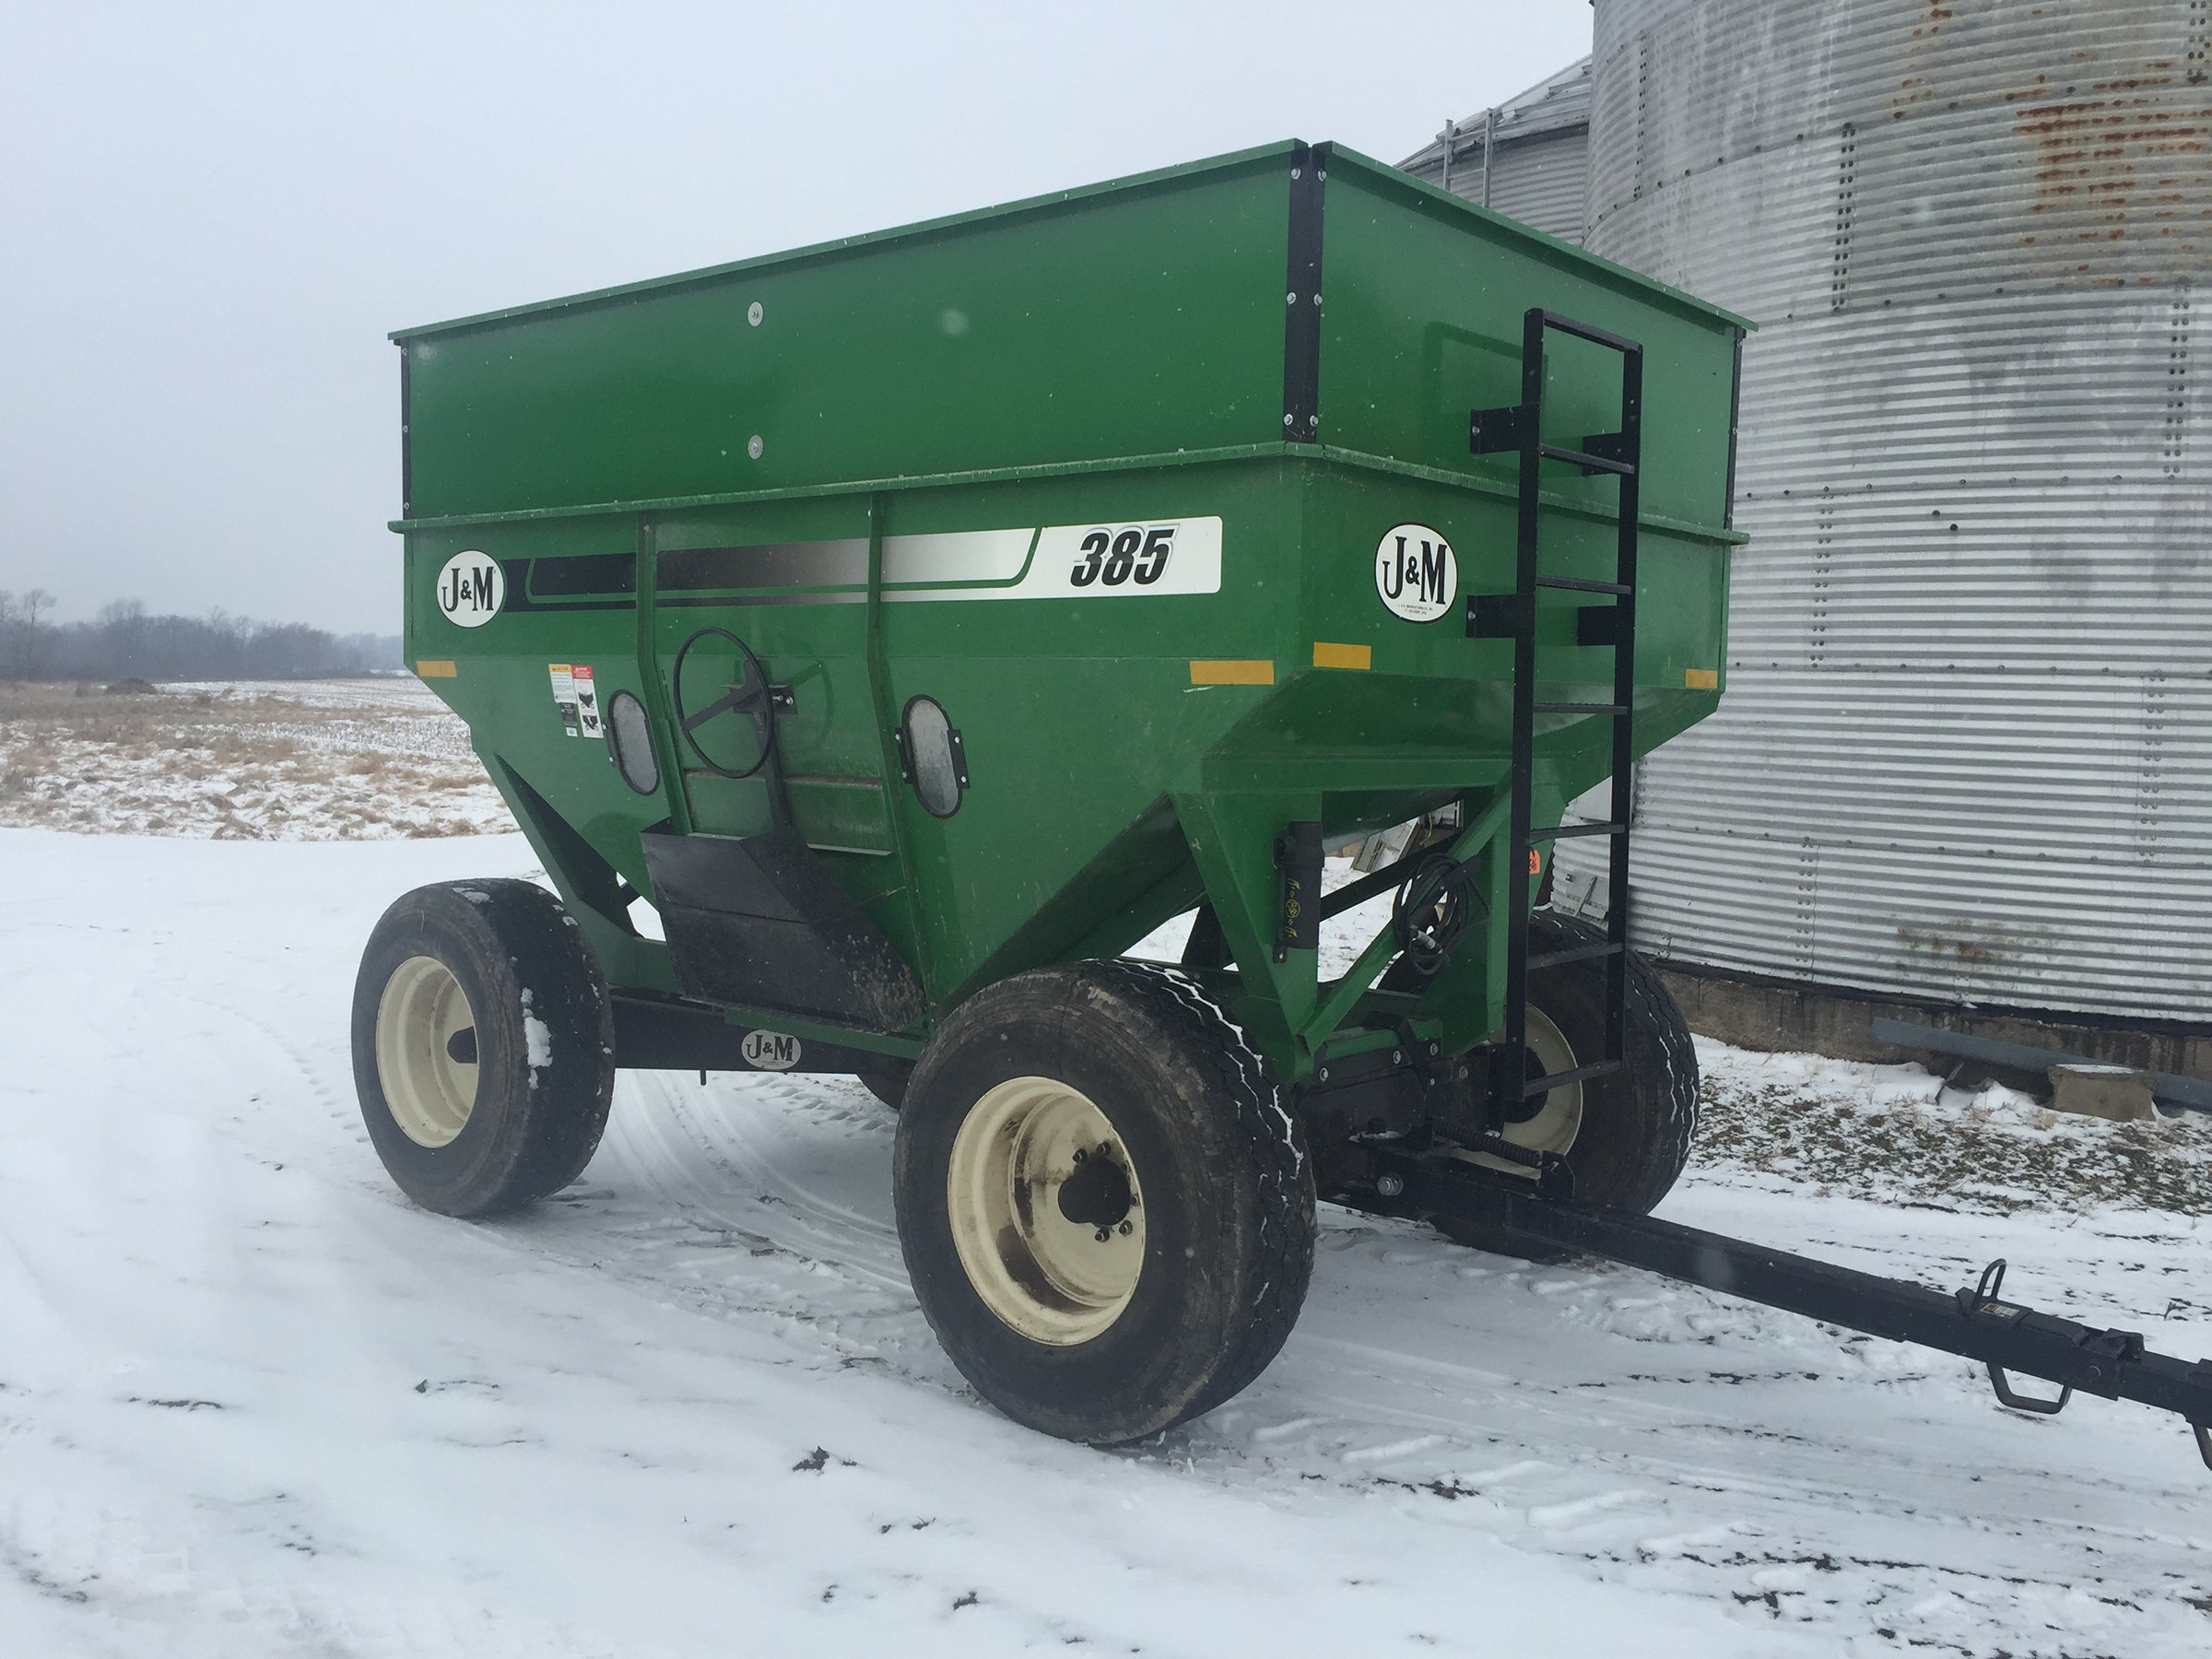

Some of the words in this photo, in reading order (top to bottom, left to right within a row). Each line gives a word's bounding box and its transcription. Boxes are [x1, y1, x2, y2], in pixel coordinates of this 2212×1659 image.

[1070, 525, 1179, 587] 385
[1382, 535, 1448, 605] J&M
[441, 566, 495, 612] J&M
[746, 1034, 794, 1062] J&M
